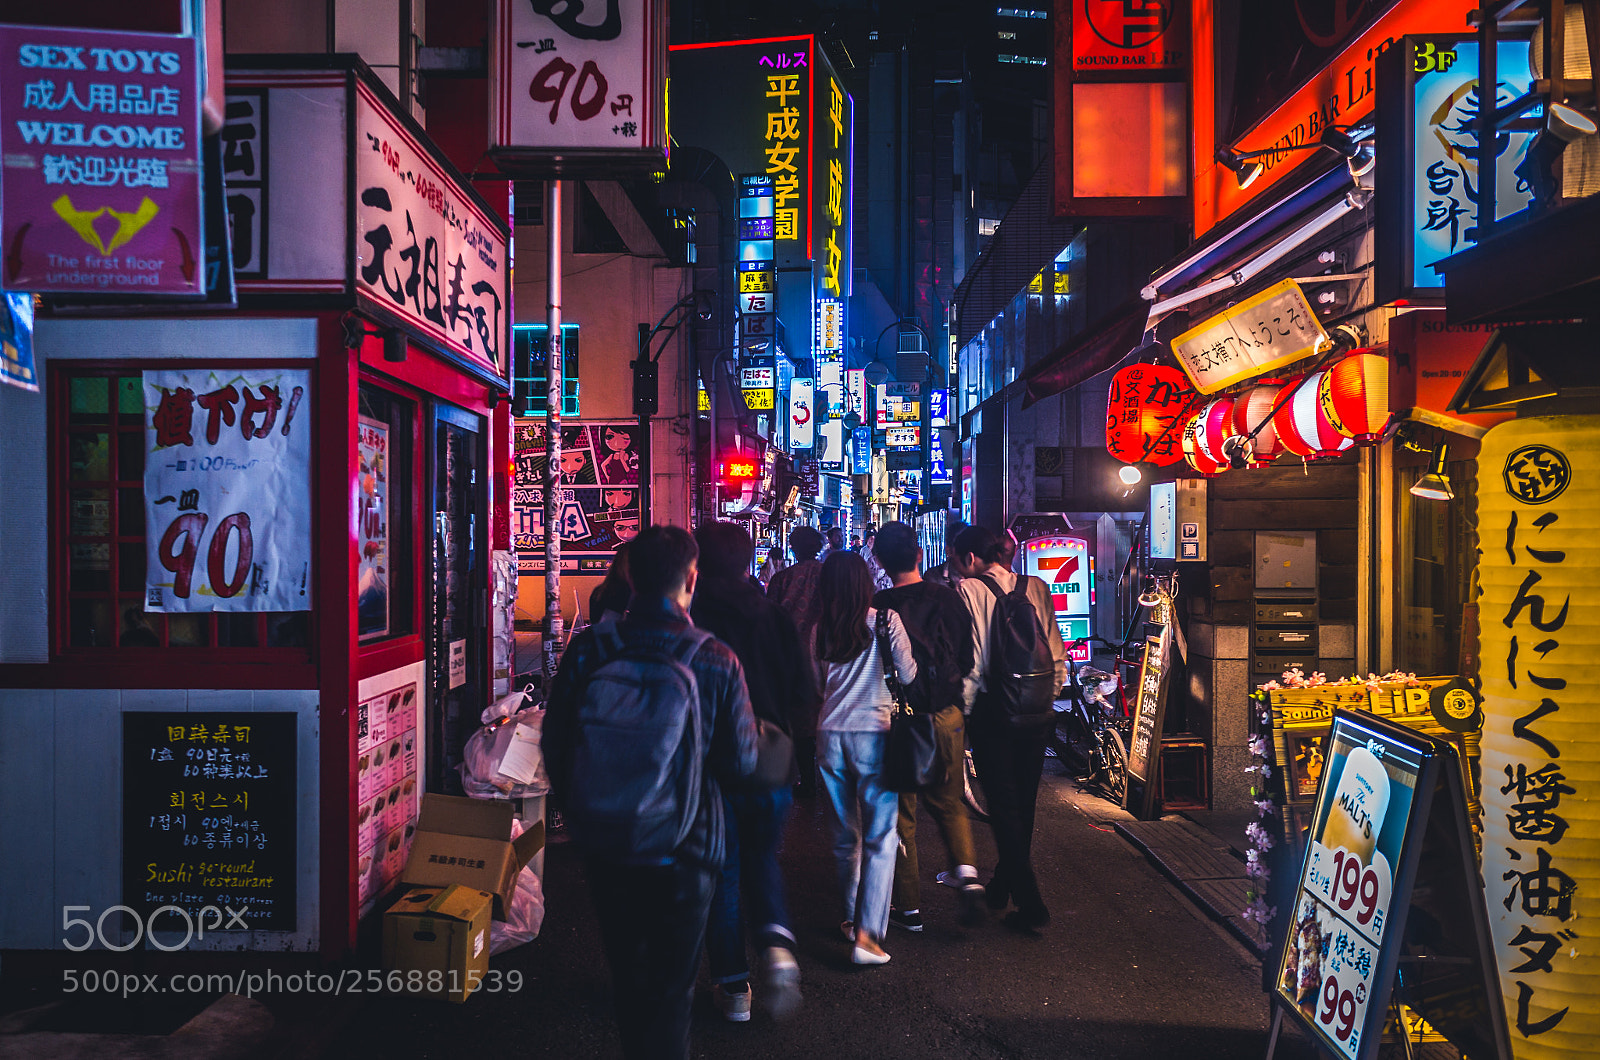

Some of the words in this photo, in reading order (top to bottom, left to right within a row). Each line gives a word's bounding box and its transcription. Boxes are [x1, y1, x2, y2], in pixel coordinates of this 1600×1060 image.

[517, 39, 556, 54] 一皿
[20, 44, 87, 70] SEX
[90, 48, 181, 75] TOYS
[758, 52, 808, 69] ヘルス
[1077, 55, 1119, 66] SOUND
[1121, 55, 1146, 65] BAR
[1150, 51, 1182, 65] LiP
[1414, 41, 1456, 73] 3F
[23, 80, 181, 117] 成人用品店
[1309, 94, 1341, 139] BAR
[17, 120, 186, 150] WELCOME
[764, 74, 801, 240] 平成女学園
[748, 188, 765, 196] 3F
[47, 253, 79, 270] The
[84, 254, 121, 271] first
[125, 256, 165, 272] floor
[748, 262, 765, 270] 2F
[46, 271, 160, 287] underground
[360, 187, 502, 363] 元祖寿司
[745, 273, 768, 283] 麻雀
[743, 369, 771, 380] たばこ
[153, 488, 200, 511] 一皿
[1369, 688, 1430, 715] LiP
[1281, 708, 1333, 720] Sound
[1500, 509, 1579, 1039] にんにく醤油ダレ
[169, 790, 249, 812] 회전스시
[149, 814, 187, 831] 1접시
[183, 832, 268, 850] 60종류이상
[146, 862, 194, 883] Sushi
[202, 877, 274, 888] restaurant
[170, 892, 204, 904] plate
[216, 894, 231, 904] 90
